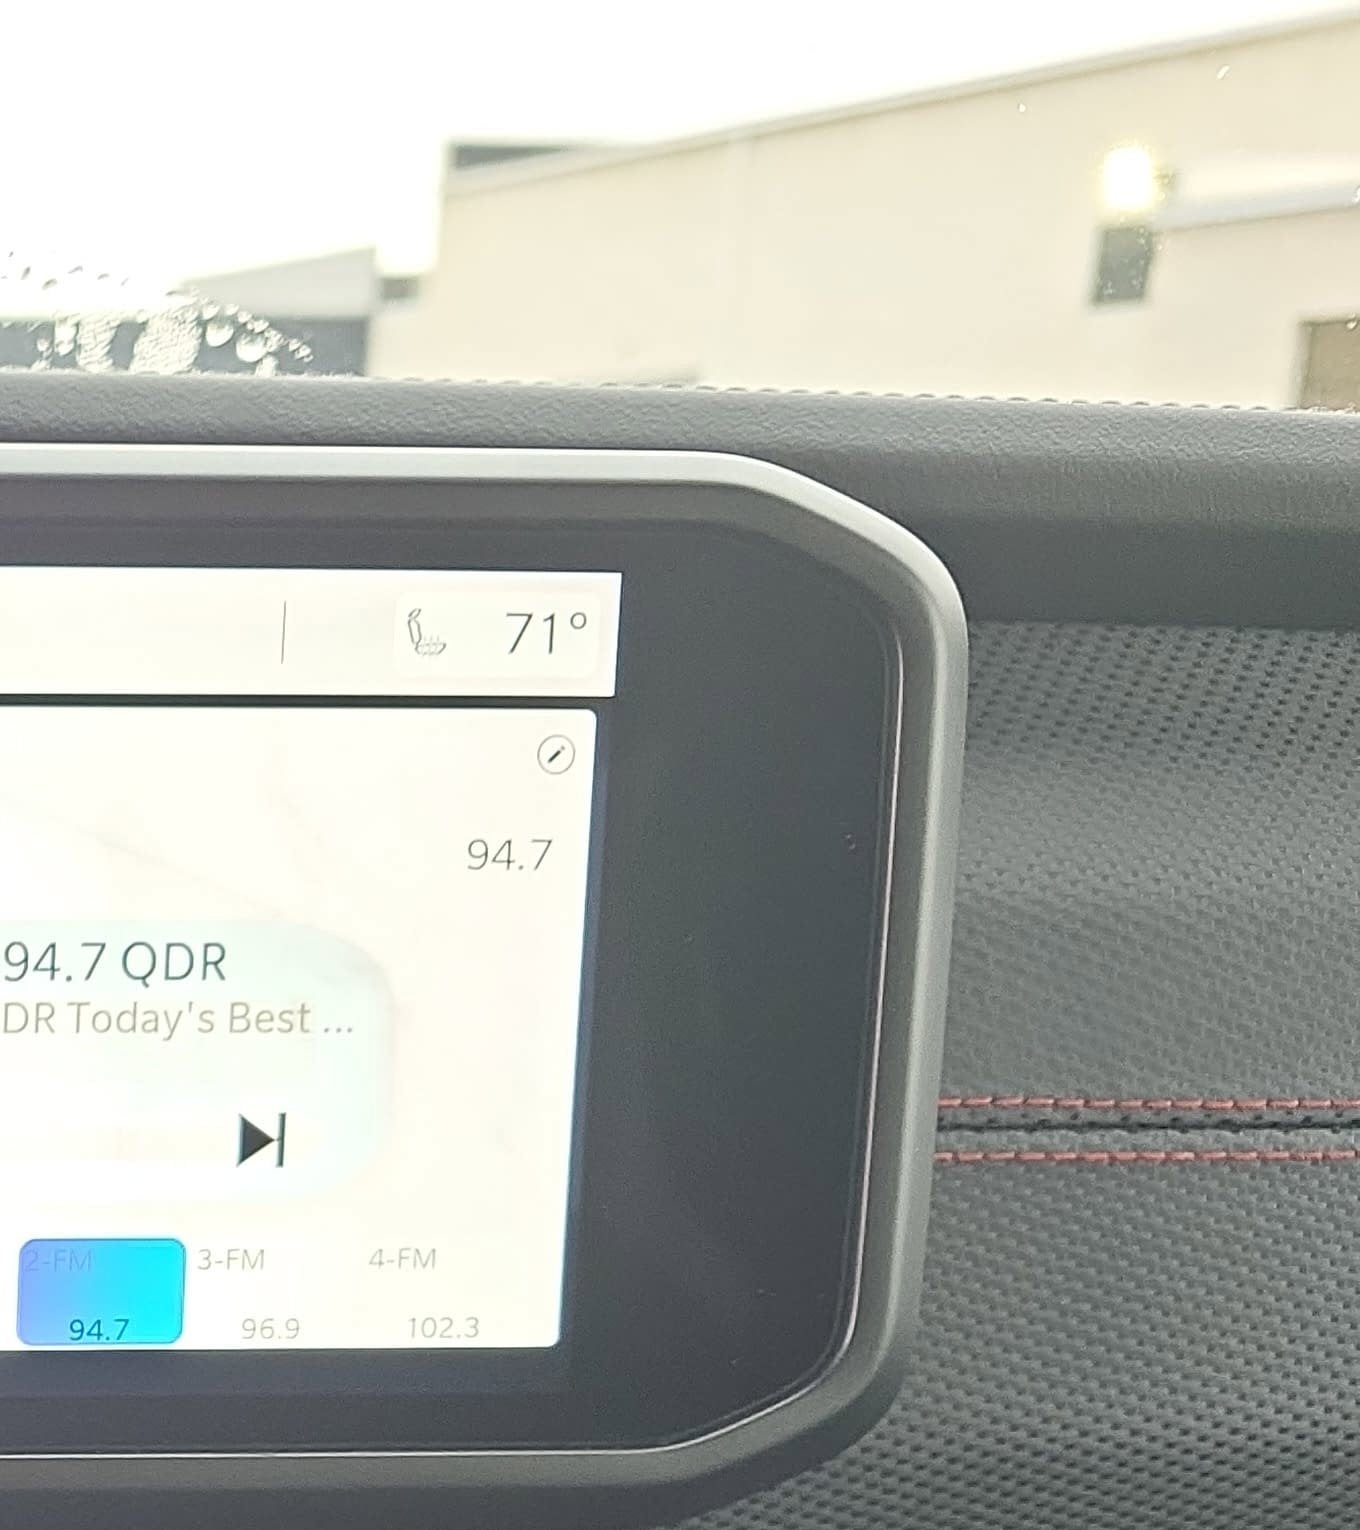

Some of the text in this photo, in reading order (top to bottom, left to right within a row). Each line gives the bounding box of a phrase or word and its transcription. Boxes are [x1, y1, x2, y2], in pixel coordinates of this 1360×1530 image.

[505, 611, 588, 655] 71°
[466, 838, 553, 872] 94.7
[3, 941, 226, 988] 94.7 QDR
[66, 1001, 216, 1042] Today's
[228, 1003, 311, 1035] Best
[23, 1248, 93, 1273] 2-FM
[197, 1248, 265, 1271] 3-FM
[368, 1246, 436, 1270] 4-FM
[68, 1317, 129, 1343] 94.7
[241, 1317, 300, 1341] 96.9
[407, 1315, 479, 1341] 102.3
